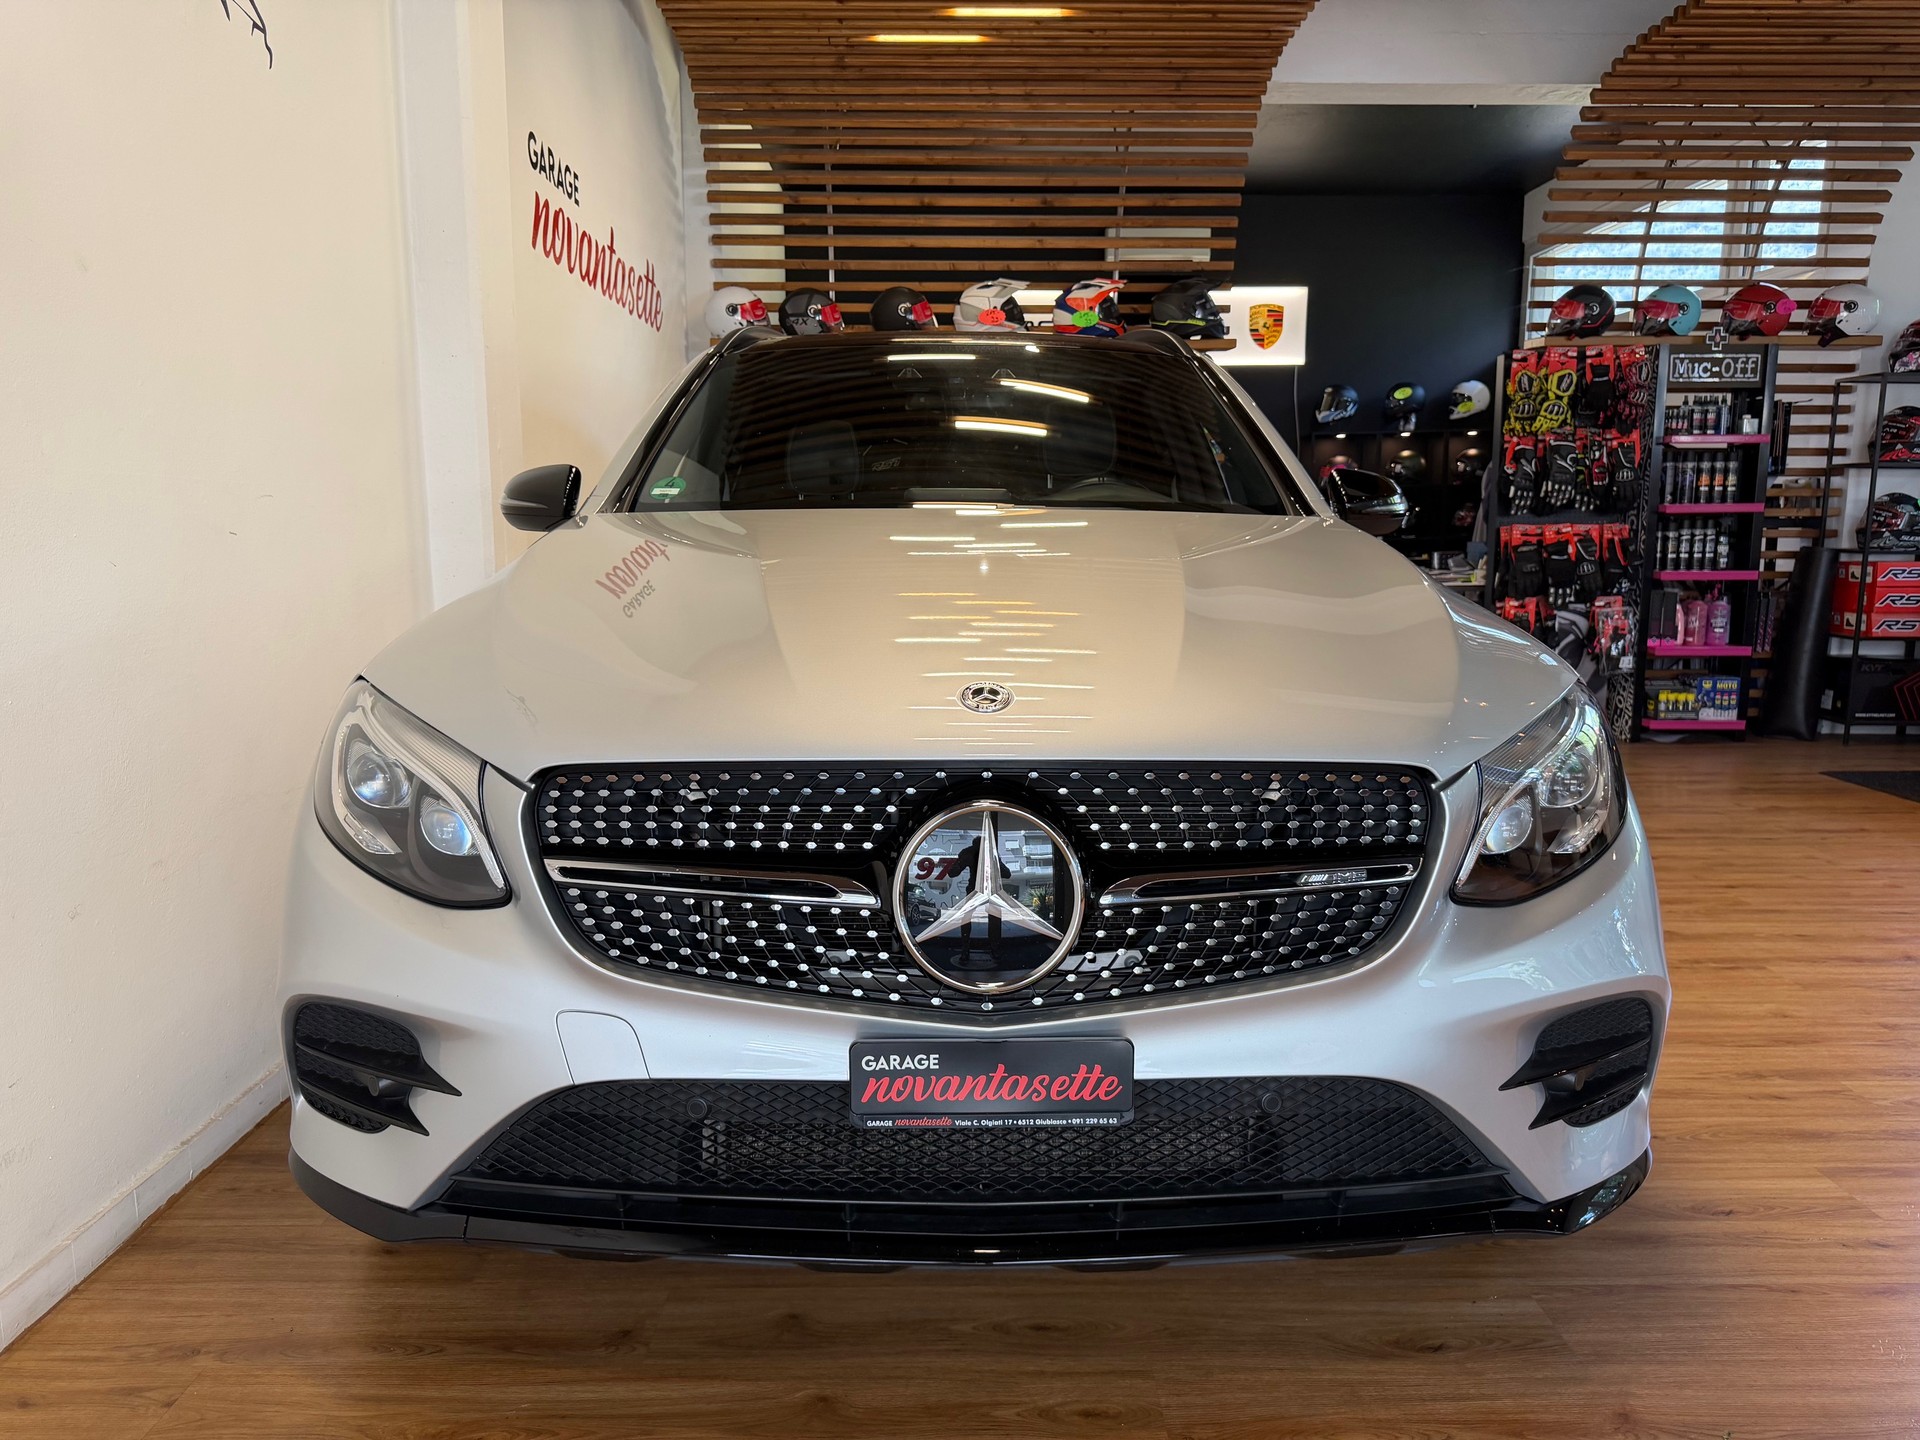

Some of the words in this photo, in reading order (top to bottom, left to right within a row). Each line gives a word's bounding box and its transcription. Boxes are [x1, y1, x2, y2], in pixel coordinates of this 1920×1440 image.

[528, 131, 580, 207] GARAGE
[531, 190, 664, 333] novantasette
[1673, 357, 1757, 378] Muc-Off
[914, 857, 960, 881] 97
[861, 1054, 940, 1071] GARAGE
[861, 1063, 1123, 1103] novantasette
[894, 1116, 953, 1127] novantasette
[981, 1119, 1003, 1127] Olgiati
[1017, 1118, 1034, 1126] 6512
[1072, 1117, 1084, 1125] 091
